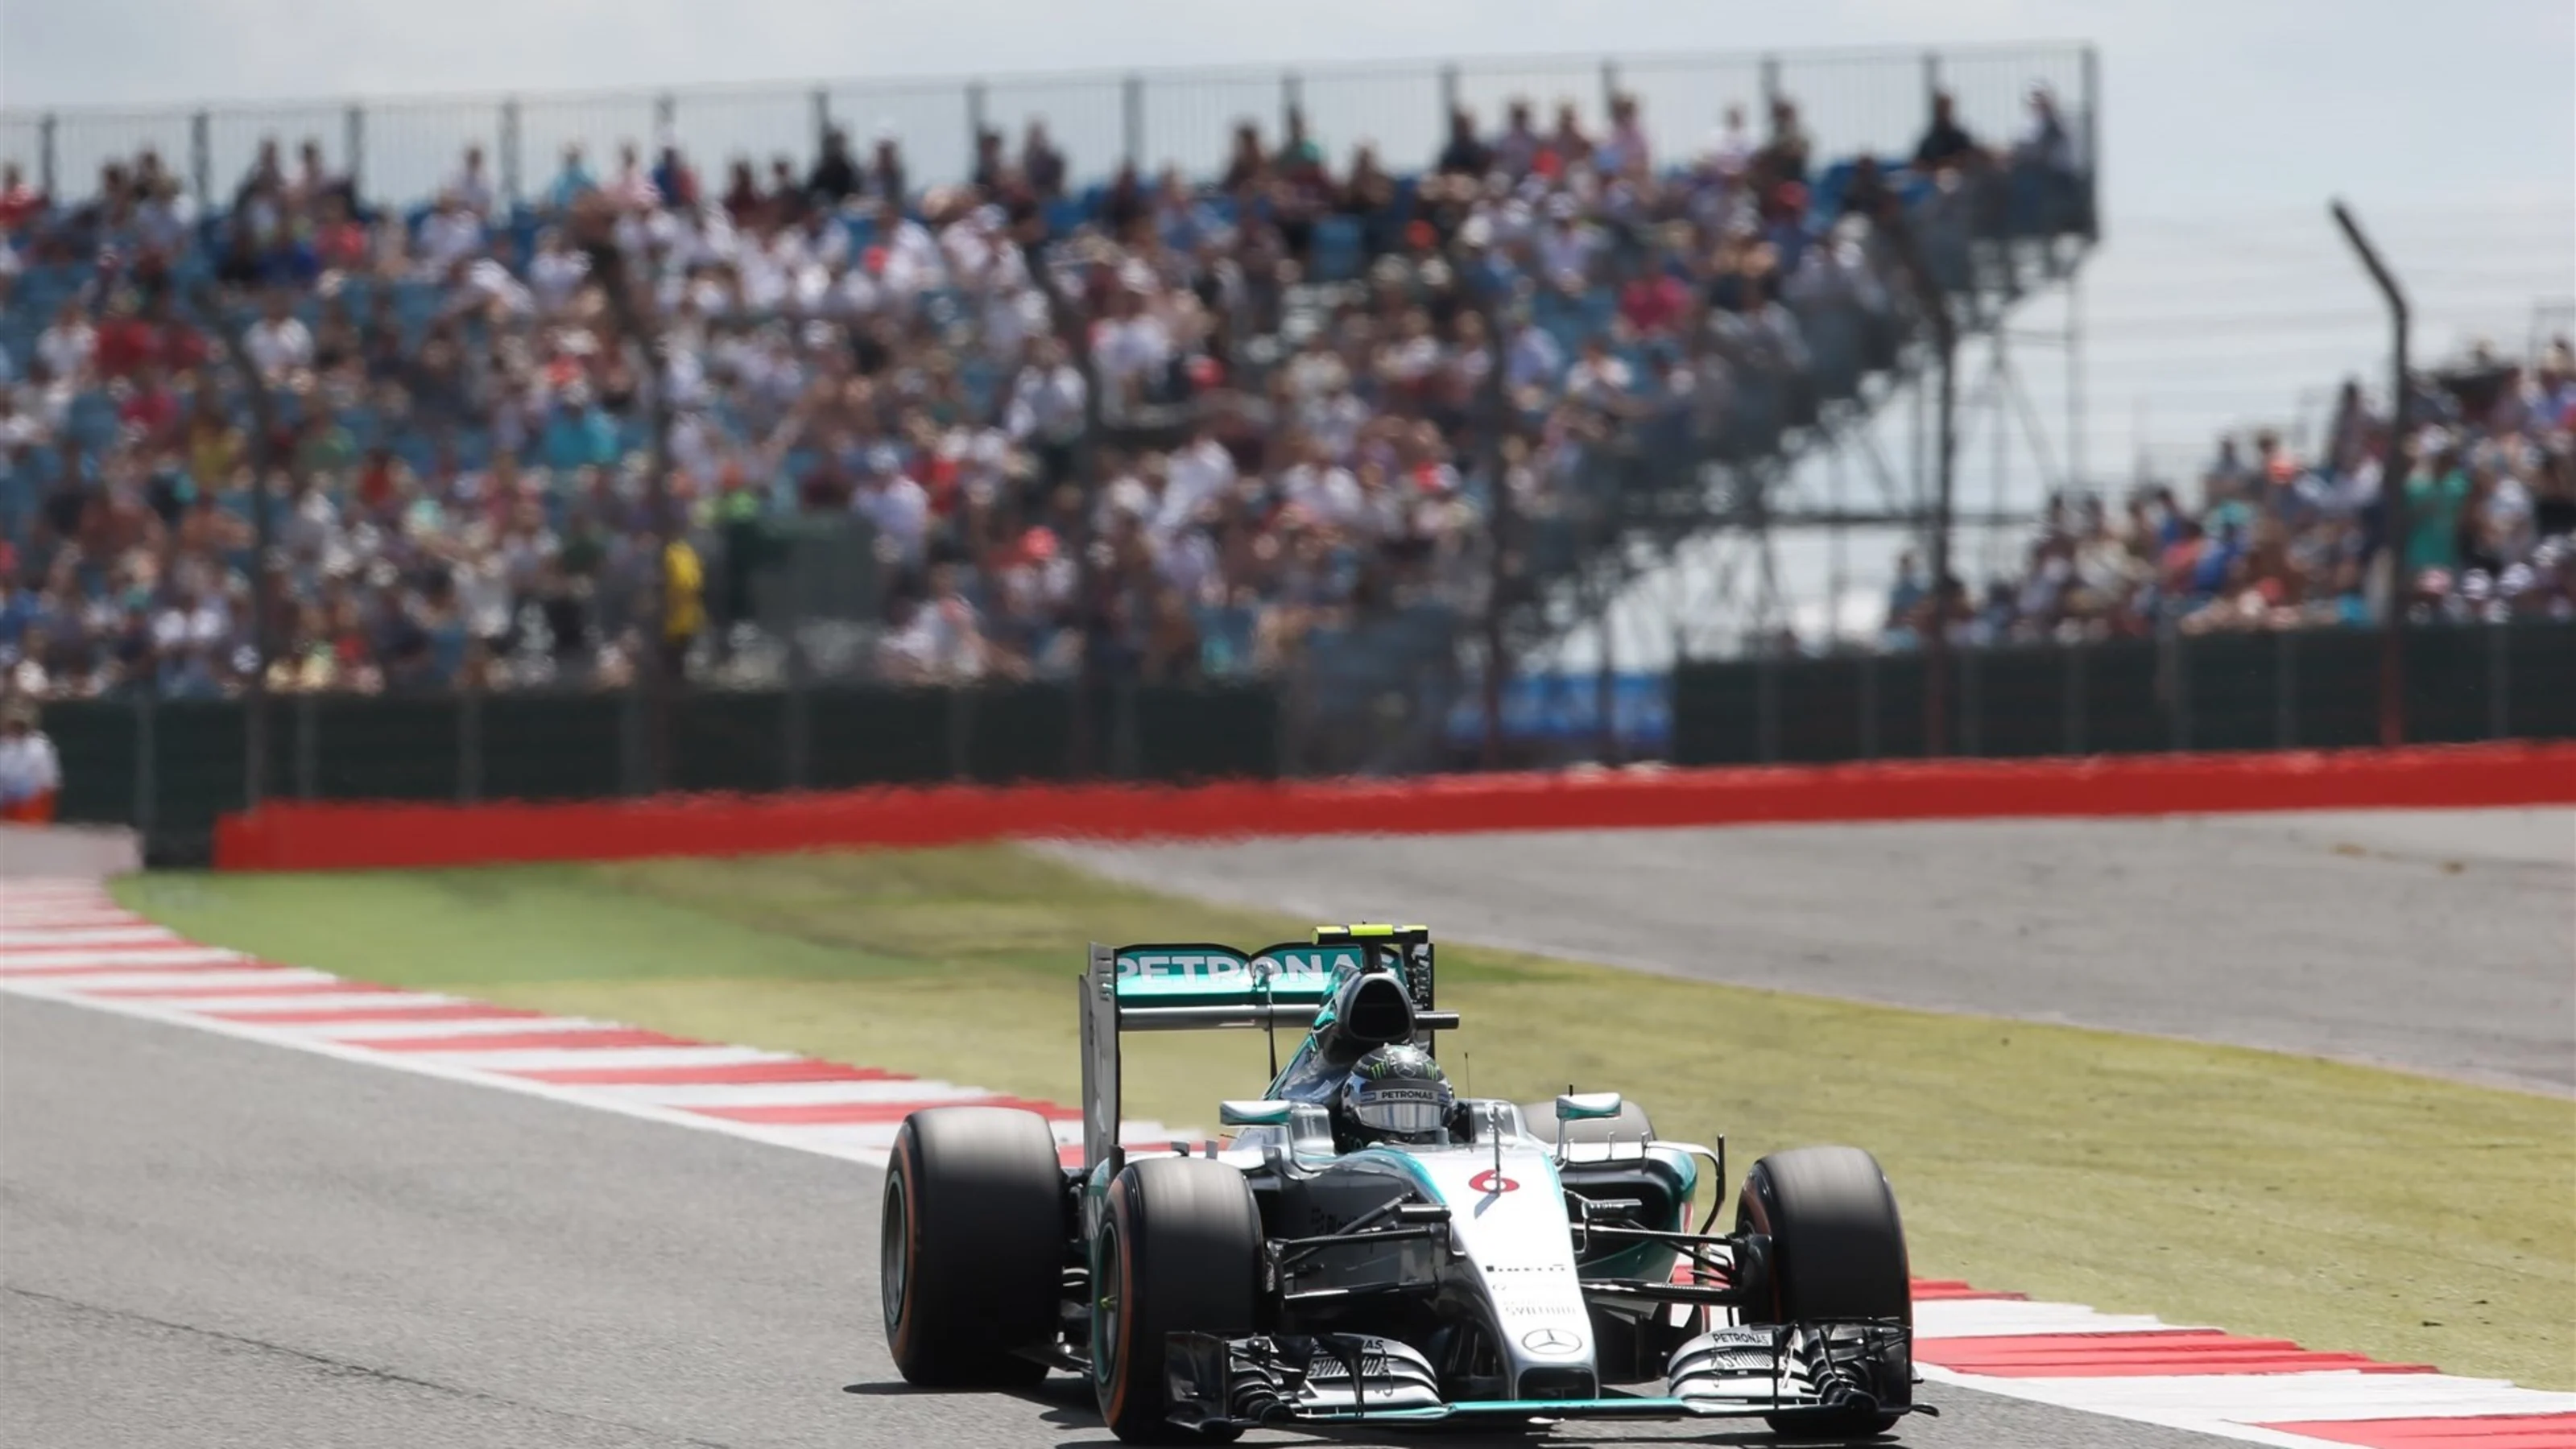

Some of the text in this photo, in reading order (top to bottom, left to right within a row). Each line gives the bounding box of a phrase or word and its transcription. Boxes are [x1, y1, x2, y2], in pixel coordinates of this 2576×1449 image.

[1381, 1090, 1434, 1100] PETRONAS
[1468, 1169, 1520, 1193] 6
[1712, 1332, 1770, 1345] PETRONAS
